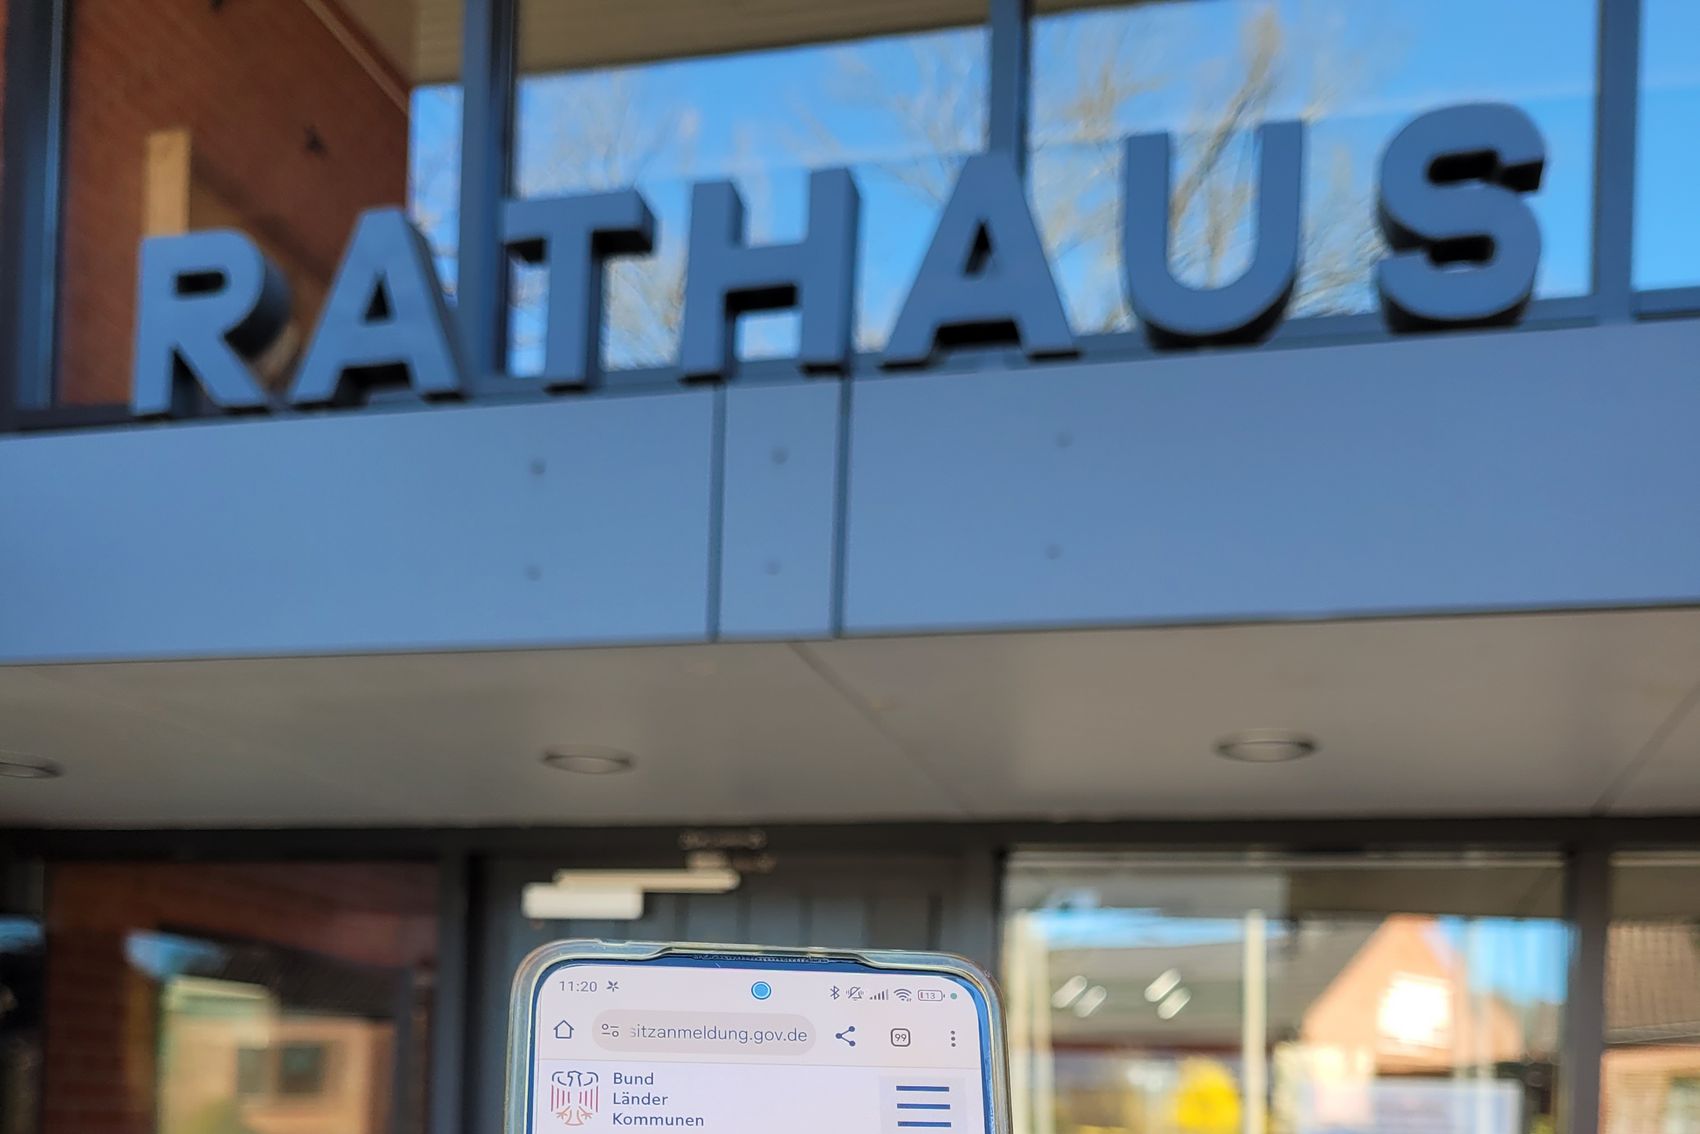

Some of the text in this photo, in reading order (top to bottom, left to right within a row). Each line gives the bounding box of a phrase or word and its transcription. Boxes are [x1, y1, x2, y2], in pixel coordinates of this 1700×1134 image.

[131, 101, 1547, 417] RATHAUS
[560, 981, 597, 992] 11:20
[925, 992, 936, 1000] 13
[614, 1072, 653, 1085] Bund
[613, 1092, 668, 1105] Länder
[613, 1113, 704, 1126] Kommunen
